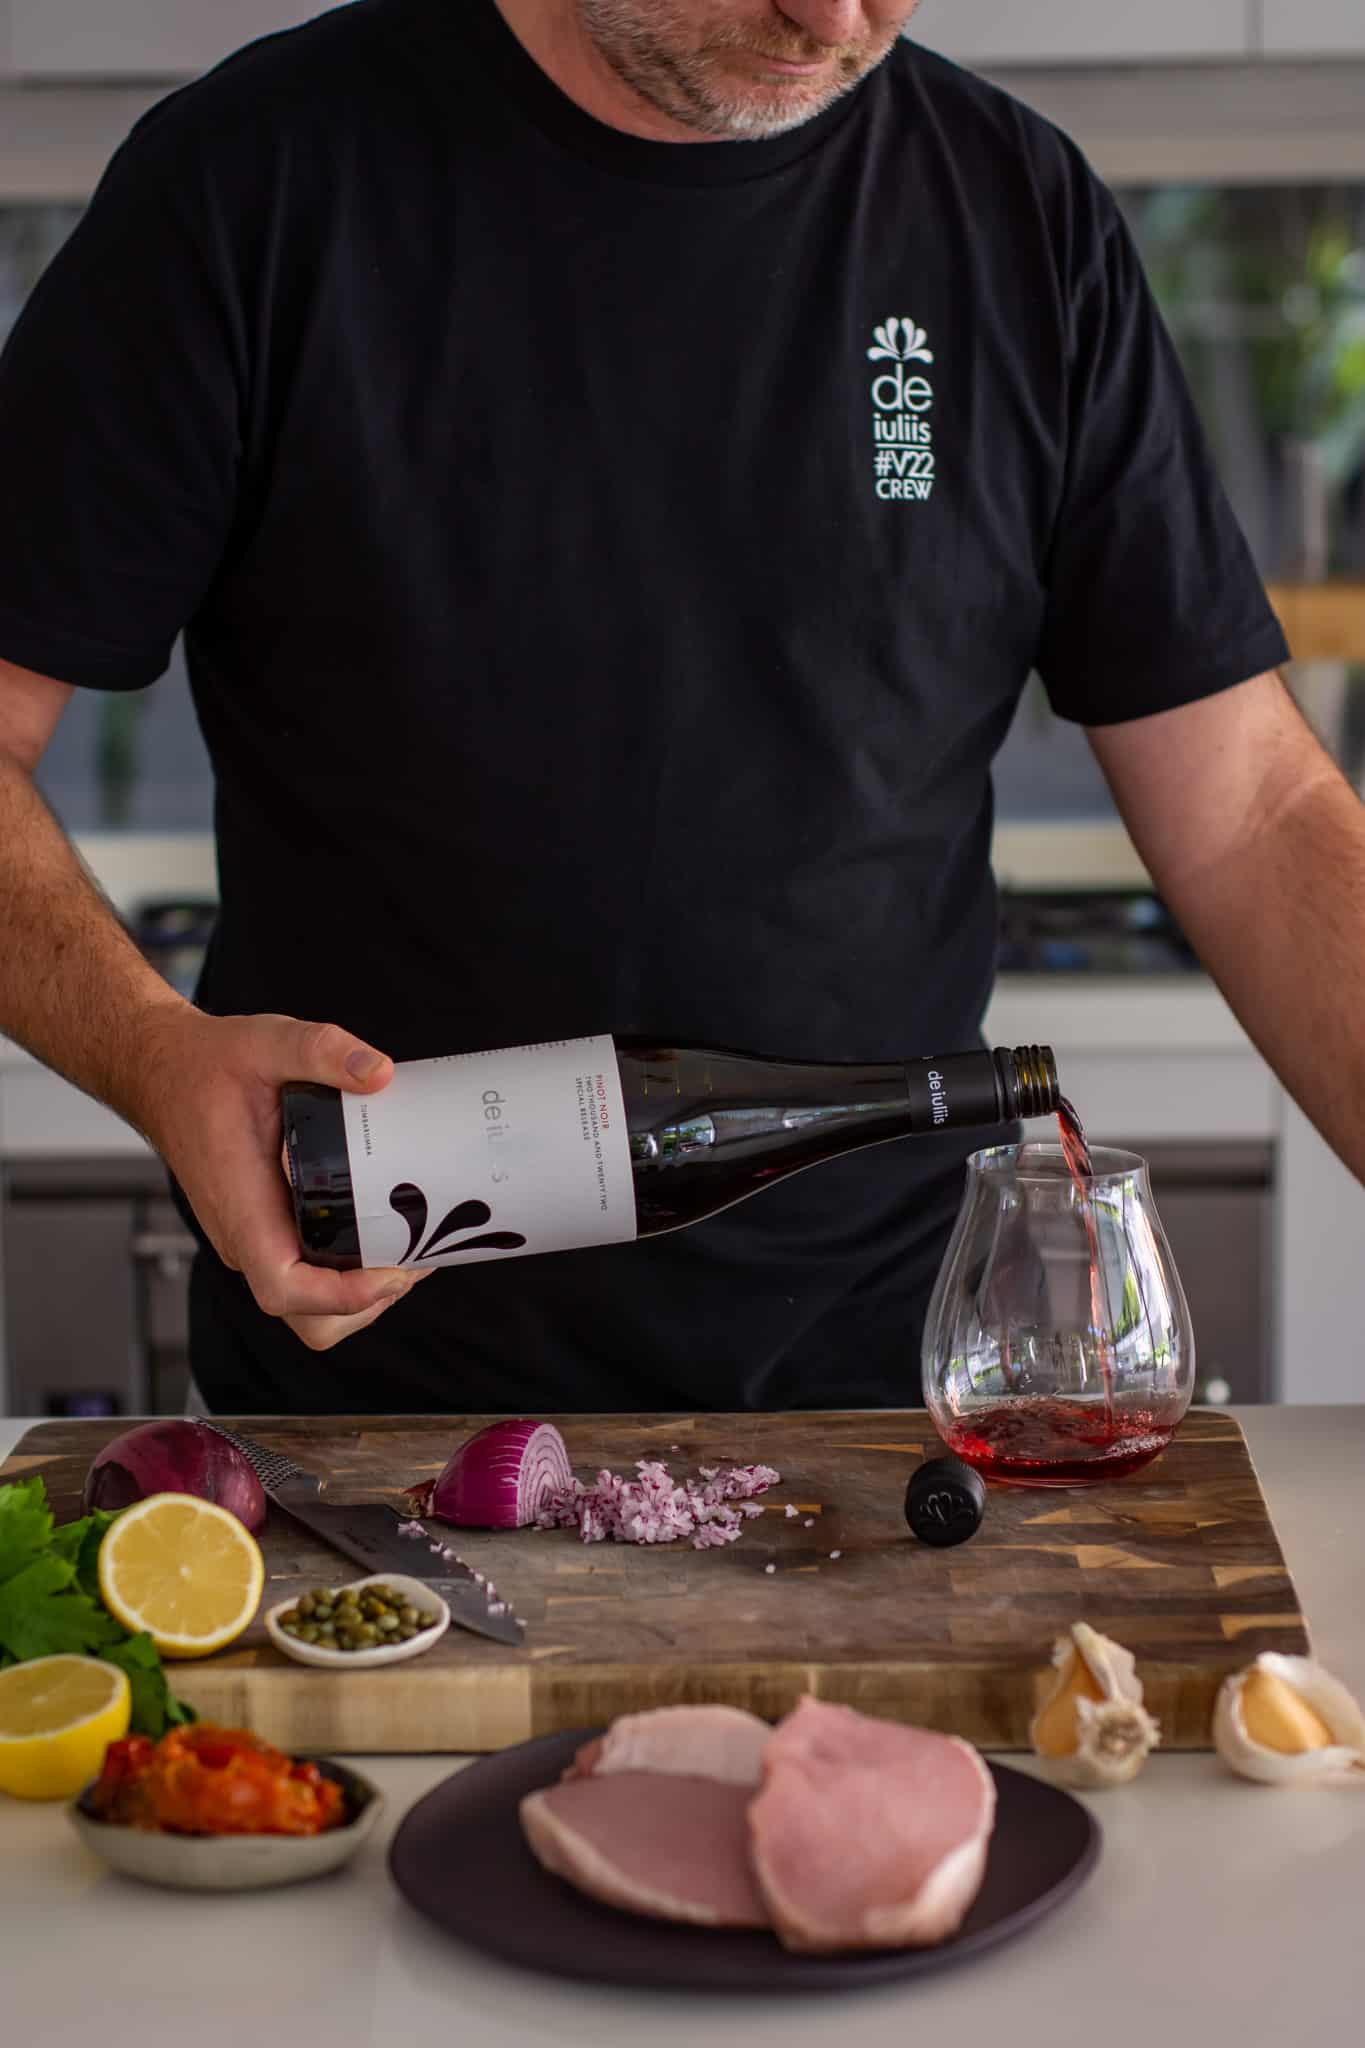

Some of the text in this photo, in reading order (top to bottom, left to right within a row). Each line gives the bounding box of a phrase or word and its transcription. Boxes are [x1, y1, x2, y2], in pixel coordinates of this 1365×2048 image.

[871, 363, 933, 412] de
[873, 412, 932, 443] iuliis
[873, 449, 936, 479] #V22
[875, 478, 933, 500] CREW
[585, 1076, 593, 1093] TWO
[928, 1071, 948, 1124] de iuliis
[482, 1090, 507, 1120] de
[587, 1093, 599, 1138] THOUSAND
[596, 1074, 610, 1129] PINOT NOIR
[594, 1140, 602, 1159] AND
